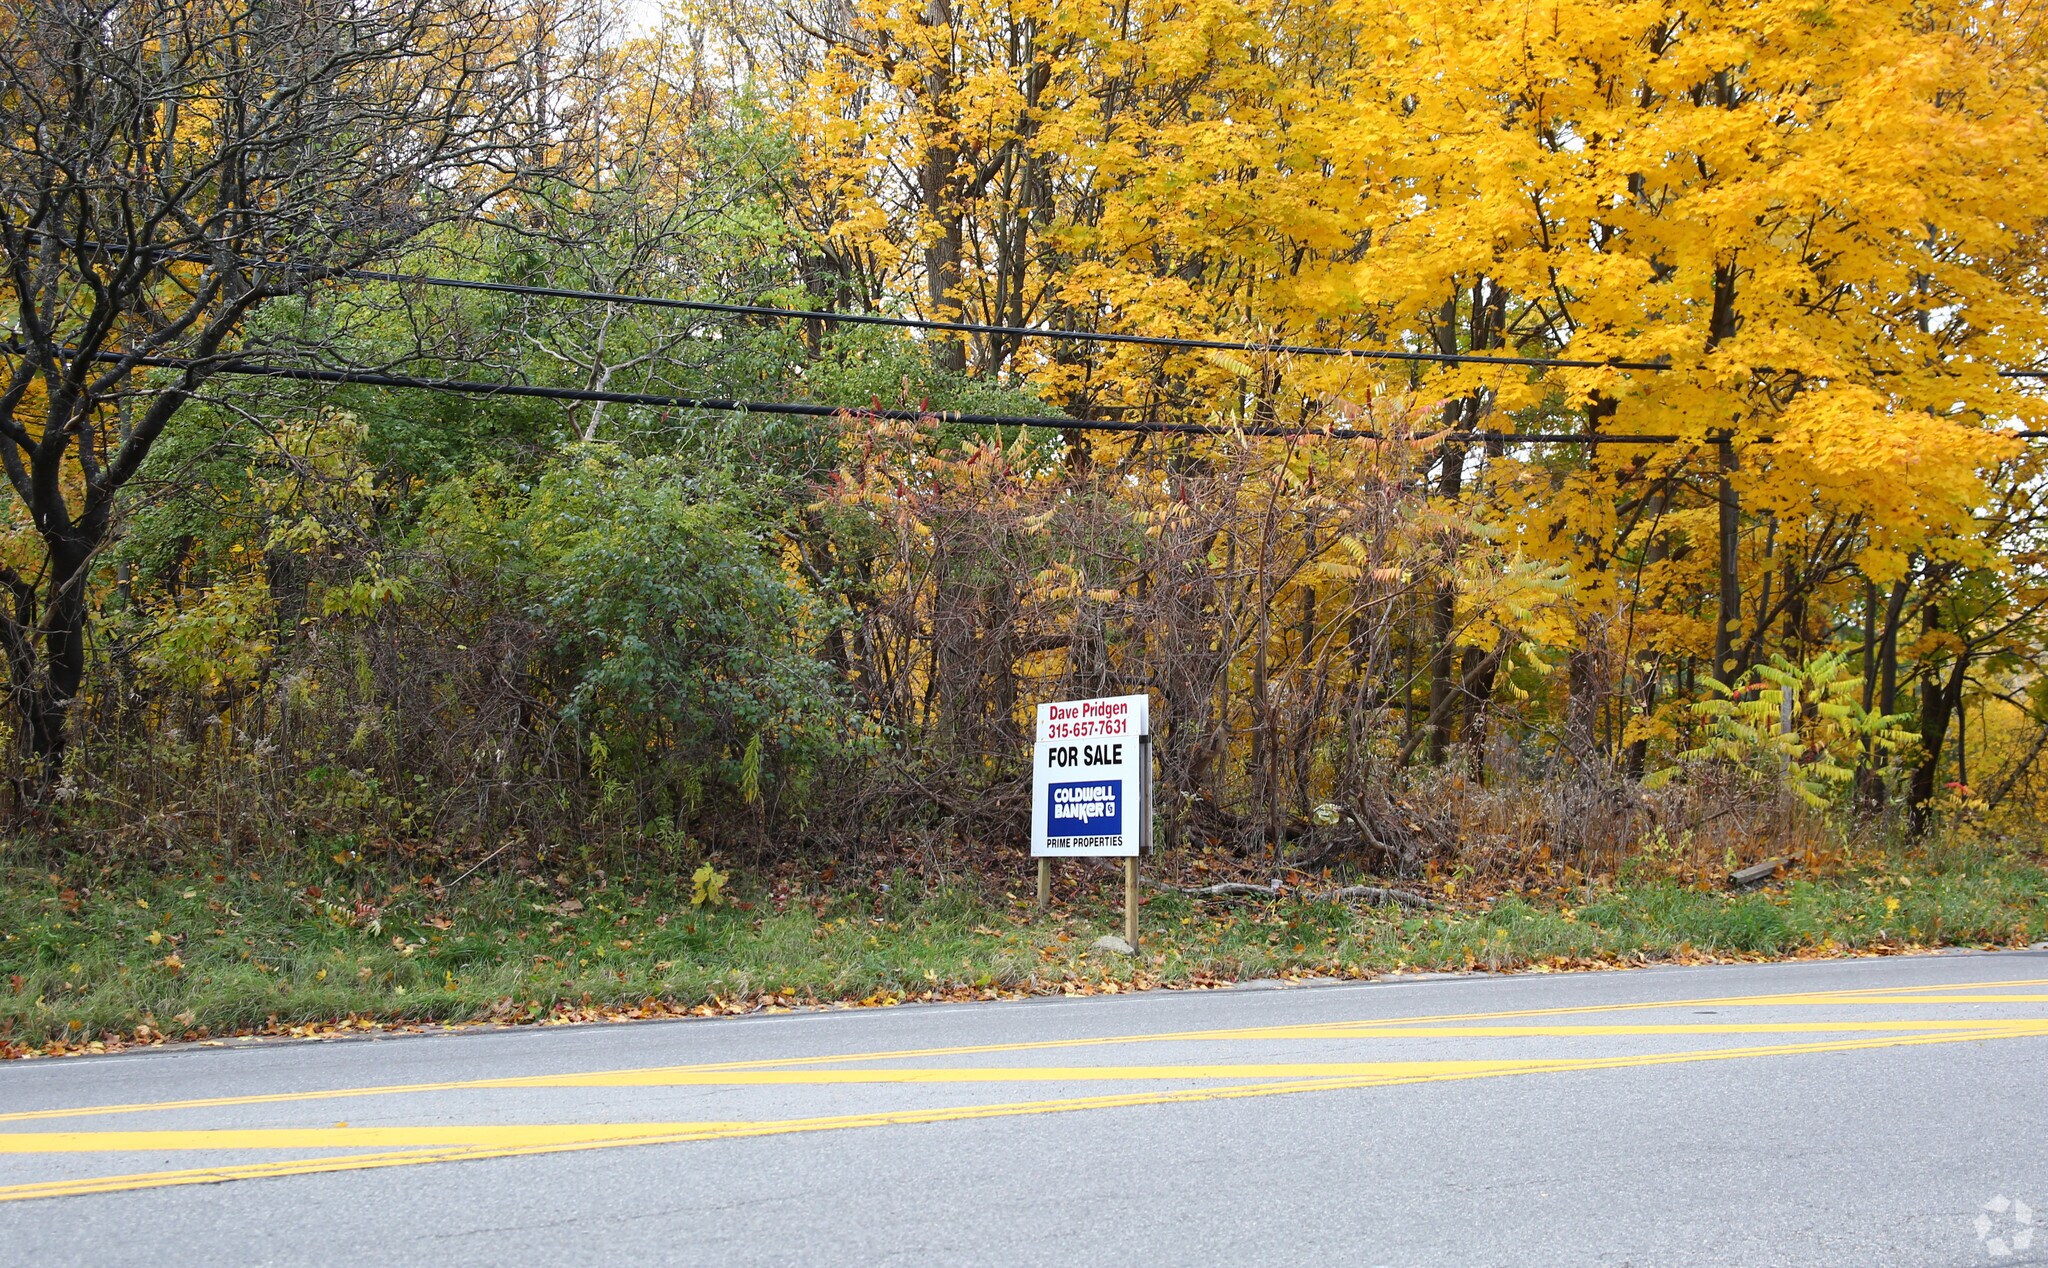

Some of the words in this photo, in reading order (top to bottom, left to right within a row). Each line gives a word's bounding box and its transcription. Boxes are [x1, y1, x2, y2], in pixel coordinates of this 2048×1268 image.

[1049, 705, 1079, 720] Dave
[1083, 701, 1128, 719] Pridgen
[1048, 718, 1127, 739] 315-657-7631
[1048, 747, 1078, 768] FOR
[1084, 743, 1122, 766] SALE
[1054, 785, 1115, 803] COLDWELL
[1054, 802, 1104, 824] BANKER
[1046, 838, 1071, 848] PRIME
[1073, 836, 1123, 848] PROPERTIES
